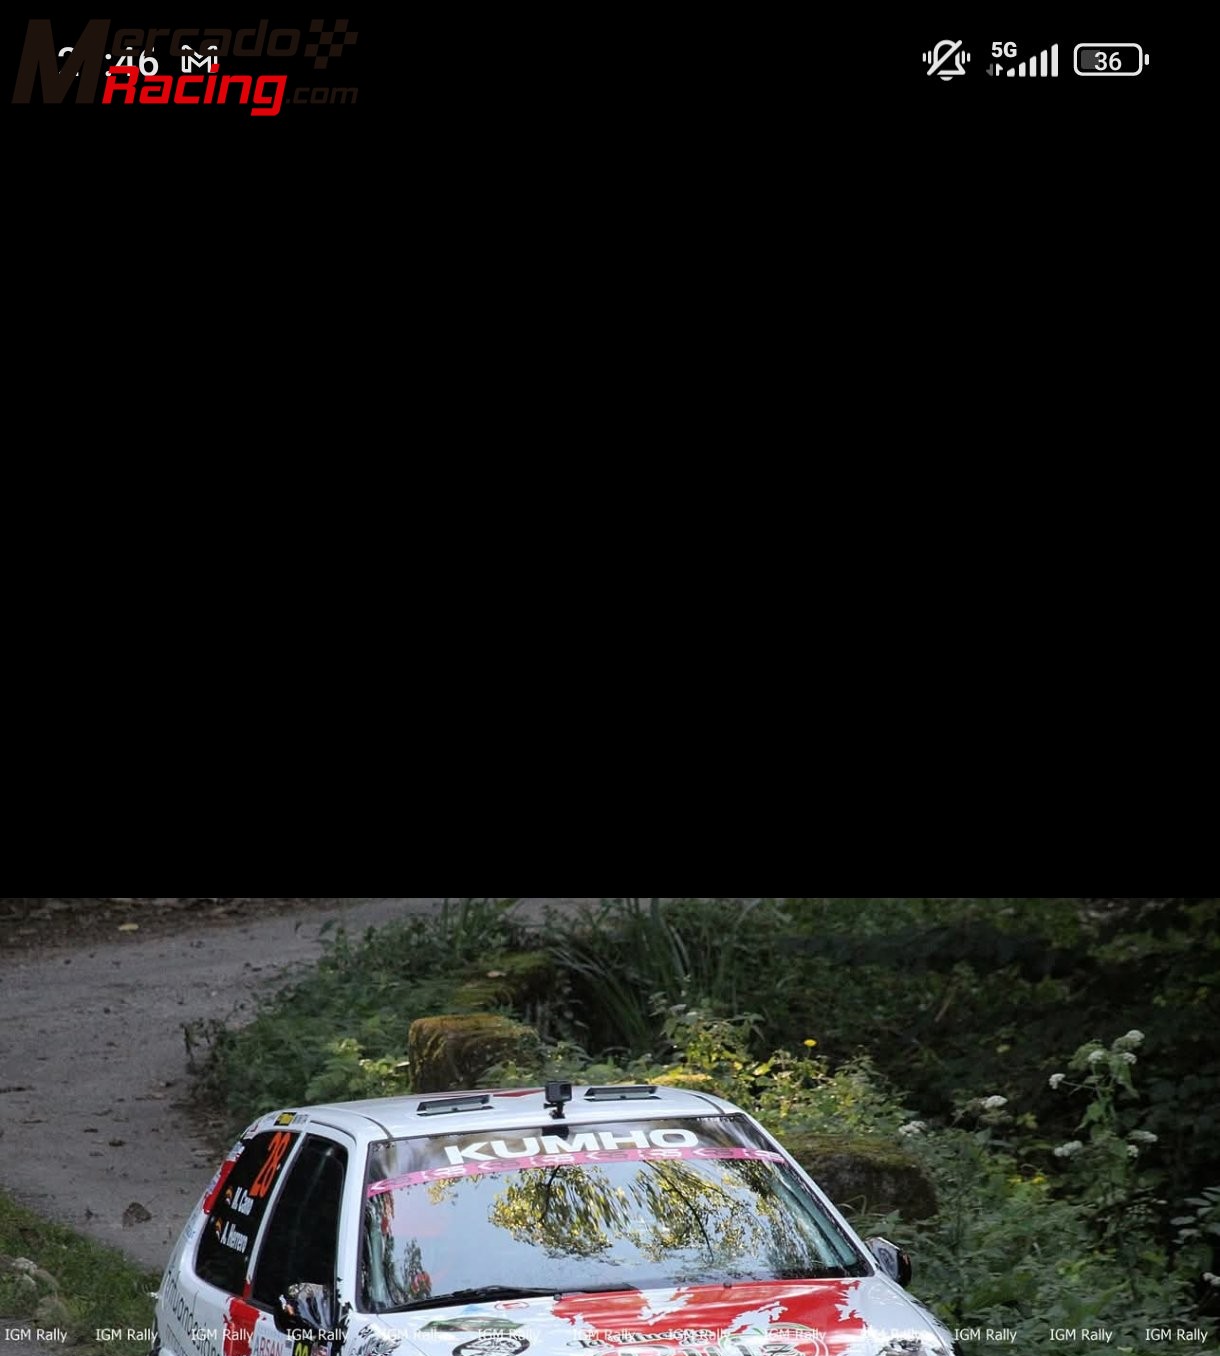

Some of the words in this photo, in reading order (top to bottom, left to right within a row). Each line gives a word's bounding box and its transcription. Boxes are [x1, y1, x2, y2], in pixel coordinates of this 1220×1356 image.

[991, 41, 1017, 58] 5G
[1094, 51, 1122, 71] 36
[444, 1129, 699, 1164] KUMHO
